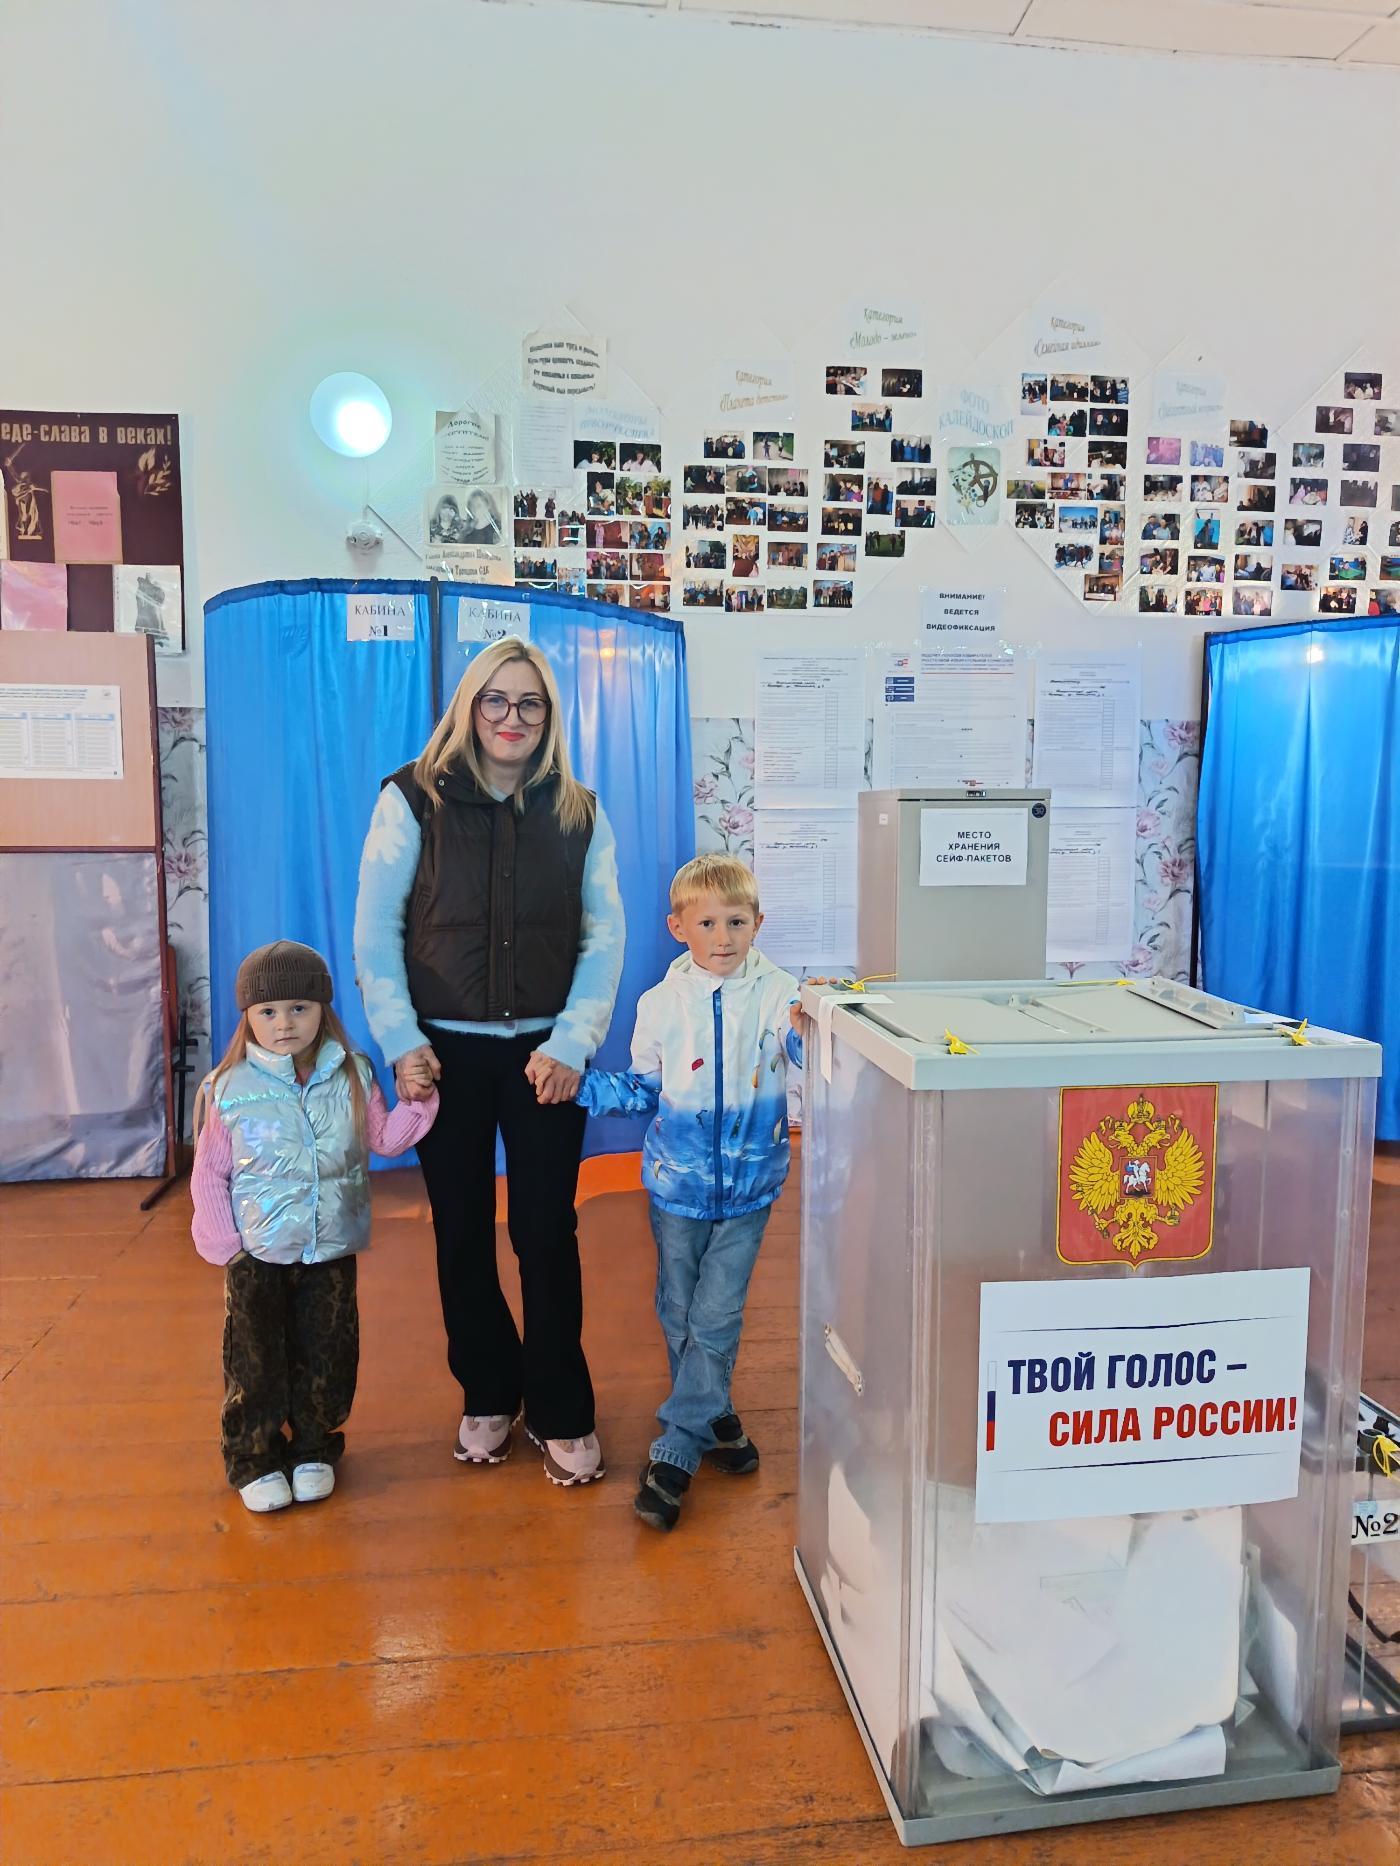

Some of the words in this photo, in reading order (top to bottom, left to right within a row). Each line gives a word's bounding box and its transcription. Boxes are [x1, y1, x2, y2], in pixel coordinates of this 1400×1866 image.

[354, 604, 406, 616] КАБИНА
[469, 606, 521, 622] КАБИНА
[957, 831, 991, 839] МЕСТО
[936, 854, 1012, 862] СЕЙФ-ПАКЕТОВ
[1007, 1352, 1095, 1394] ТВОЙ
[1107, 1349, 1216, 1389] ГОЛОС
[1049, 1408, 1141, 1447] СИЛА
[1153, 1397, 1297, 1440] РОССИИ!
[1351, 1513, 1398, 1538] №2
